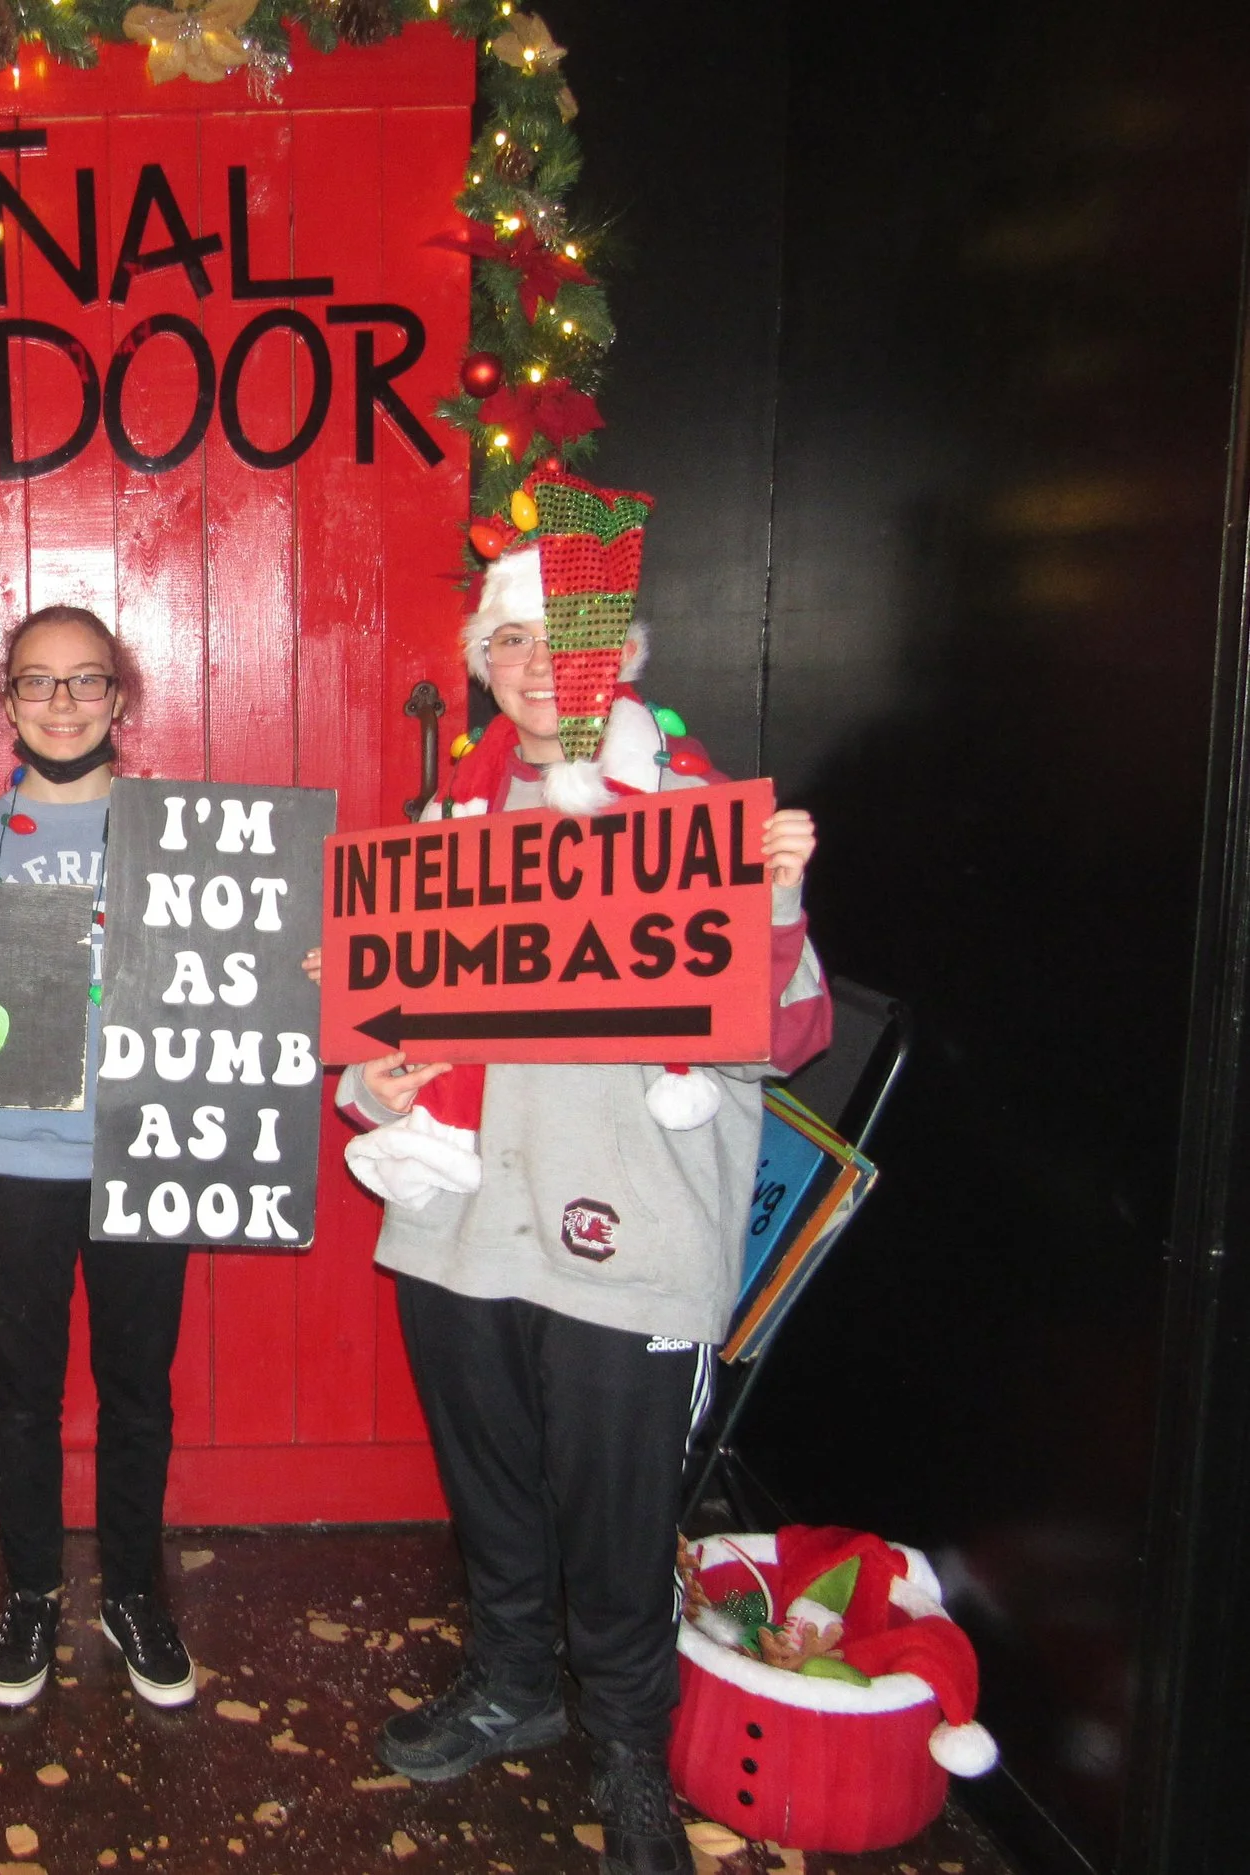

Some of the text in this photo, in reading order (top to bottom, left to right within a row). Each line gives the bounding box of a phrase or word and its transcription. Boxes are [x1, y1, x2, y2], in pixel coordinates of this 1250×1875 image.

[159, 797, 276, 854] I'M
[6, 851, 107, 885] ERI
[333, 800, 765, 918] INTELLECTUAL
[143, 873, 287, 931] NOT
[161, 951, 258, 1006] AS
[348, 909, 733, 991] DUMBASS
[99, 1025, 316, 1085] DUMB
[128, 1104, 281, 1162] AS I
[102, 1180, 299, 1239] LOOK
[646, 1338, 693, 1353] adidas
